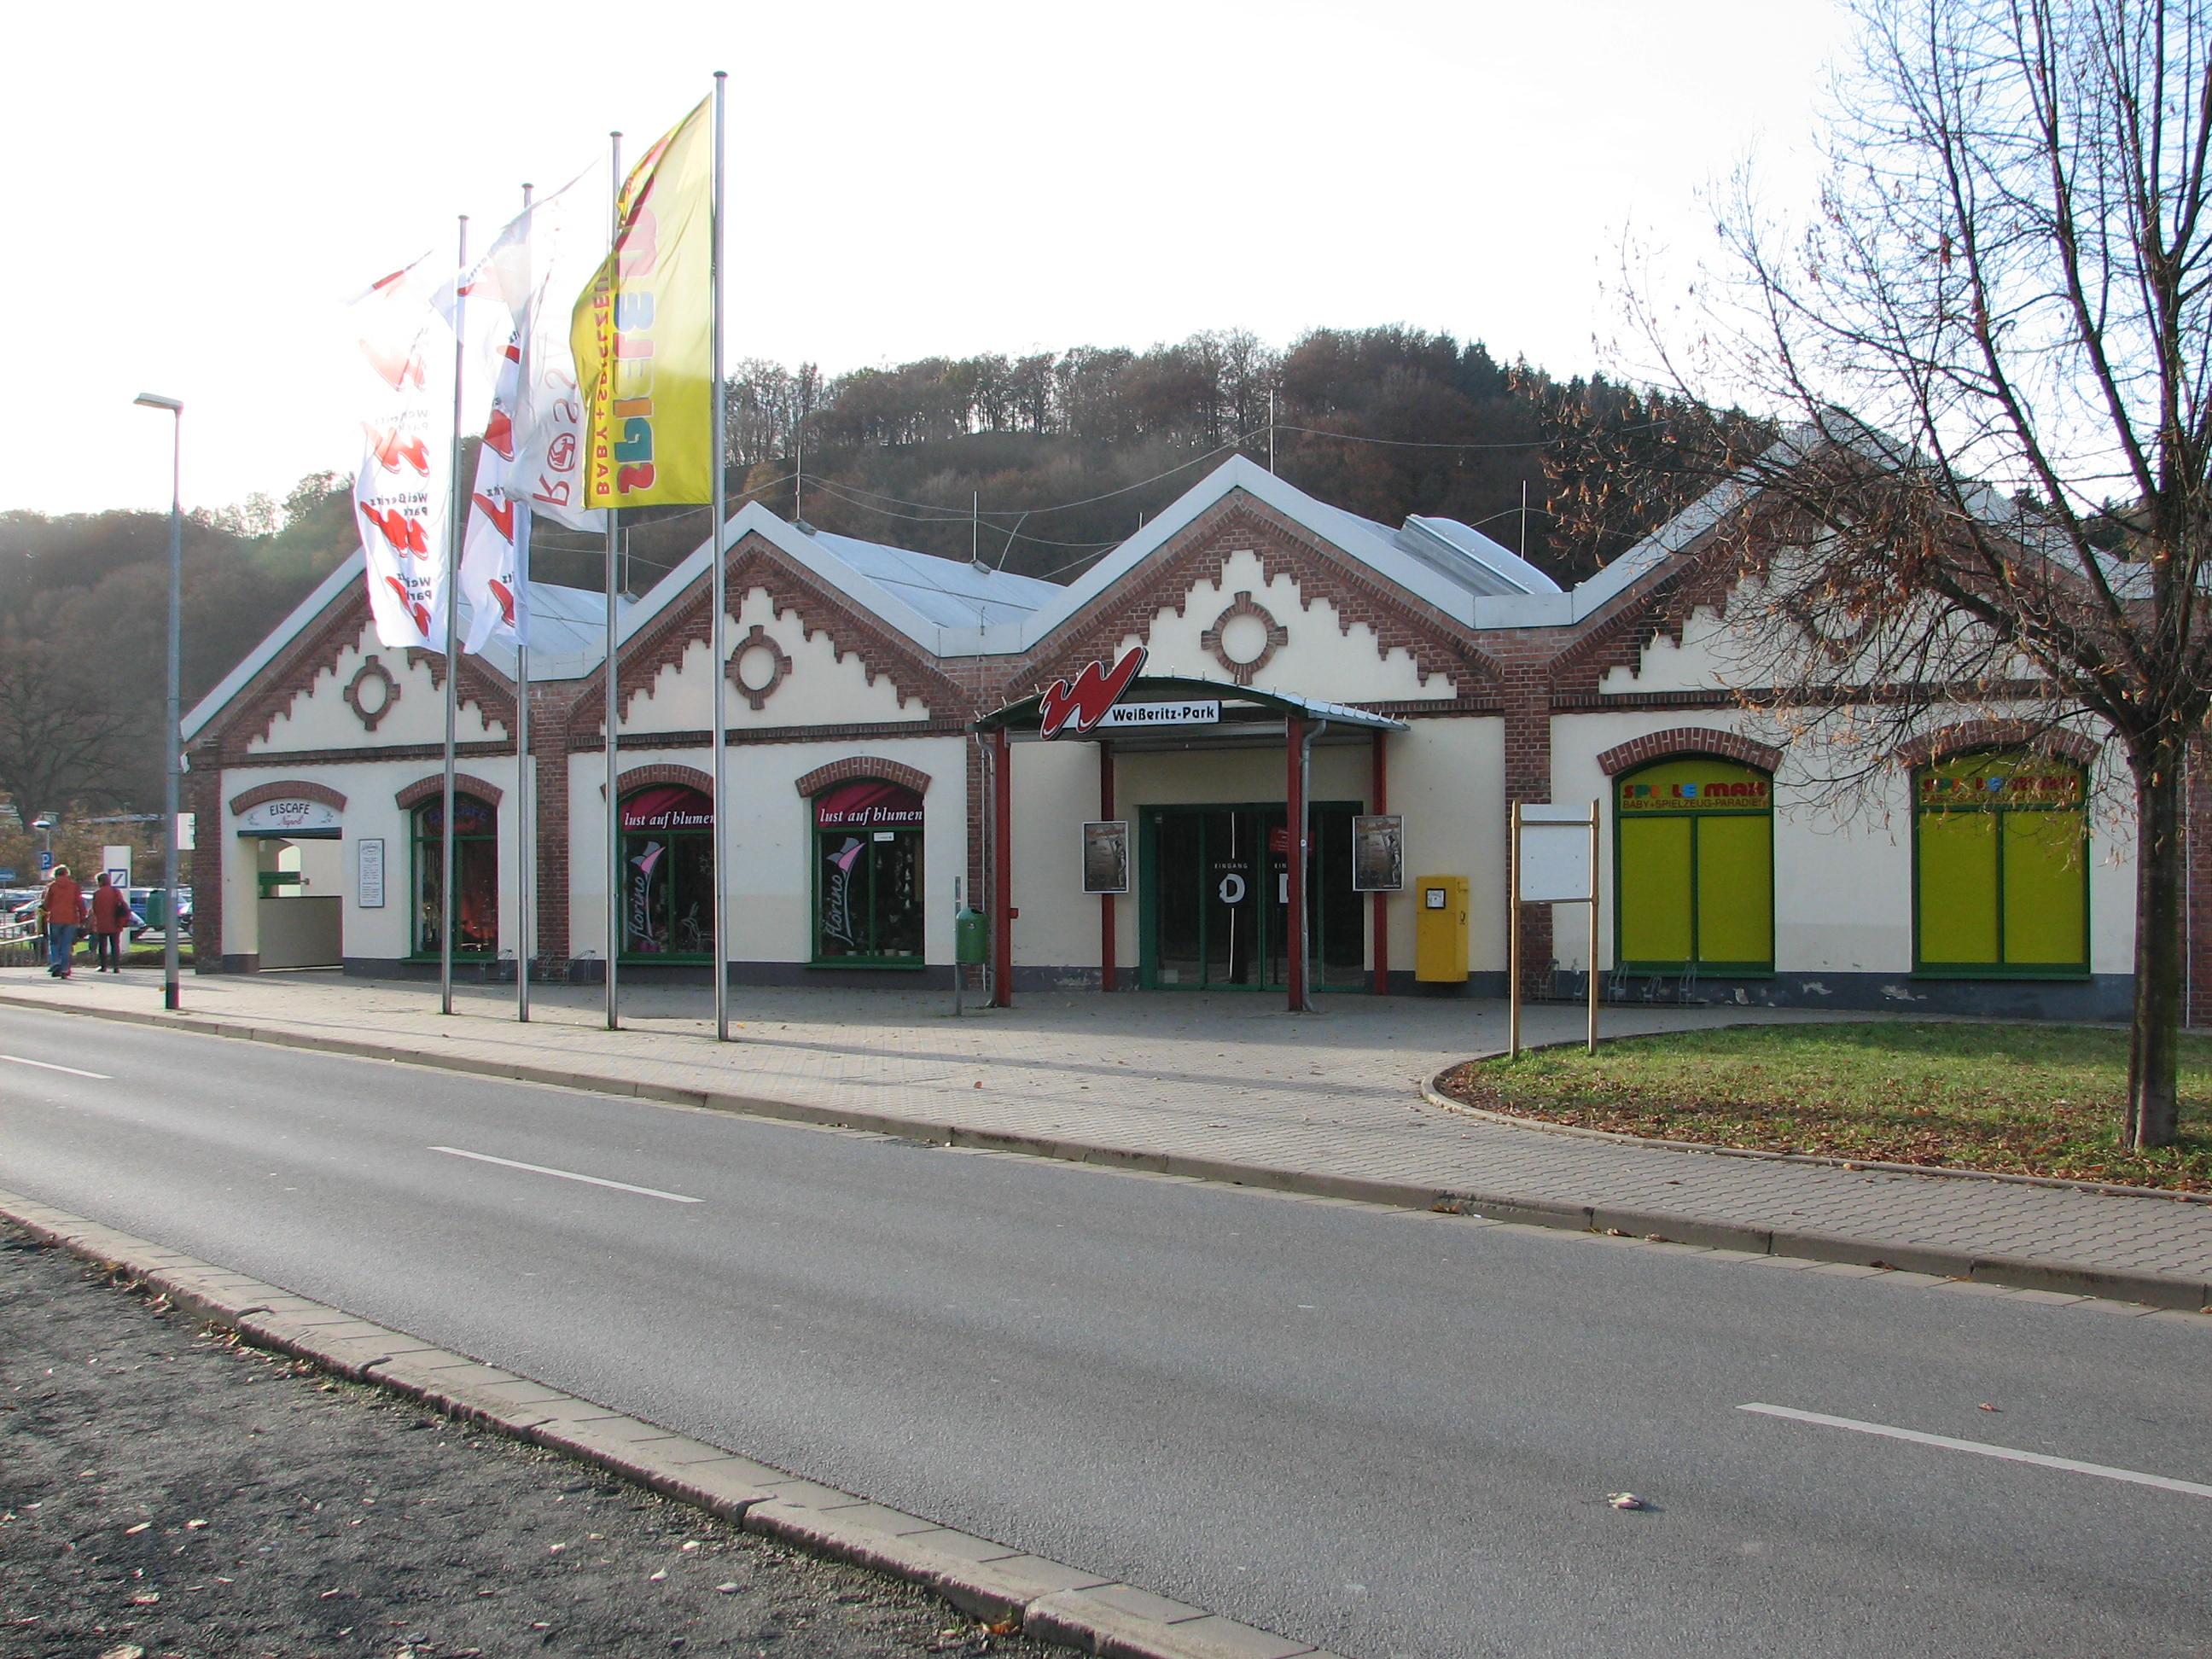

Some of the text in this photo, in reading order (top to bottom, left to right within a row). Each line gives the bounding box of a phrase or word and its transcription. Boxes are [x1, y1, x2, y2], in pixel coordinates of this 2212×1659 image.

[1112, 706, 1214, 722] Weißeritz-Park
[625, 812, 646, 826] lust
[649, 812, 672, 829] auf
[820, 807, 923, 825] lust auf blumen
